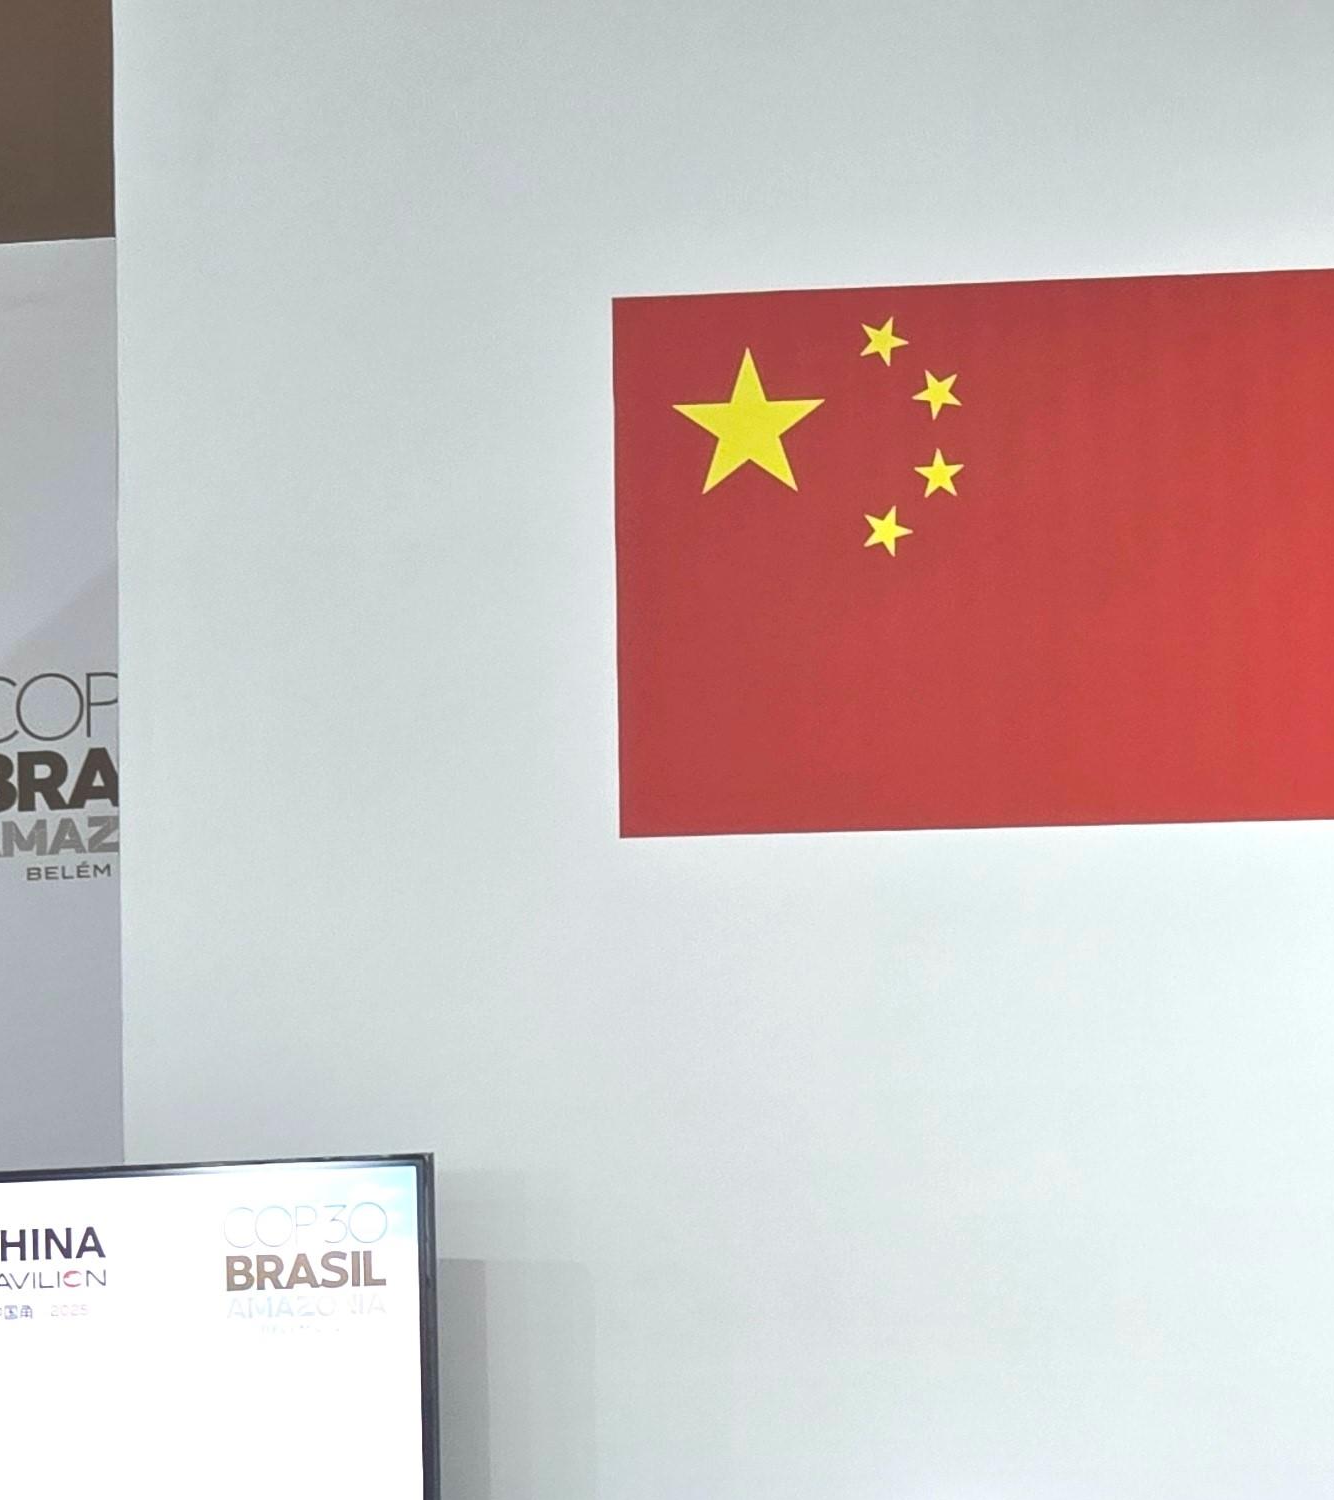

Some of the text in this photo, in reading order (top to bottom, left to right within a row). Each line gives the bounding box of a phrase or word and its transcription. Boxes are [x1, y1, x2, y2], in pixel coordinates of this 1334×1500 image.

[26, 862, 112, 881] BELÉM
[224, 1201, 388, 1248] COP30
[225, 1250, 387, 1292] BRASIL
